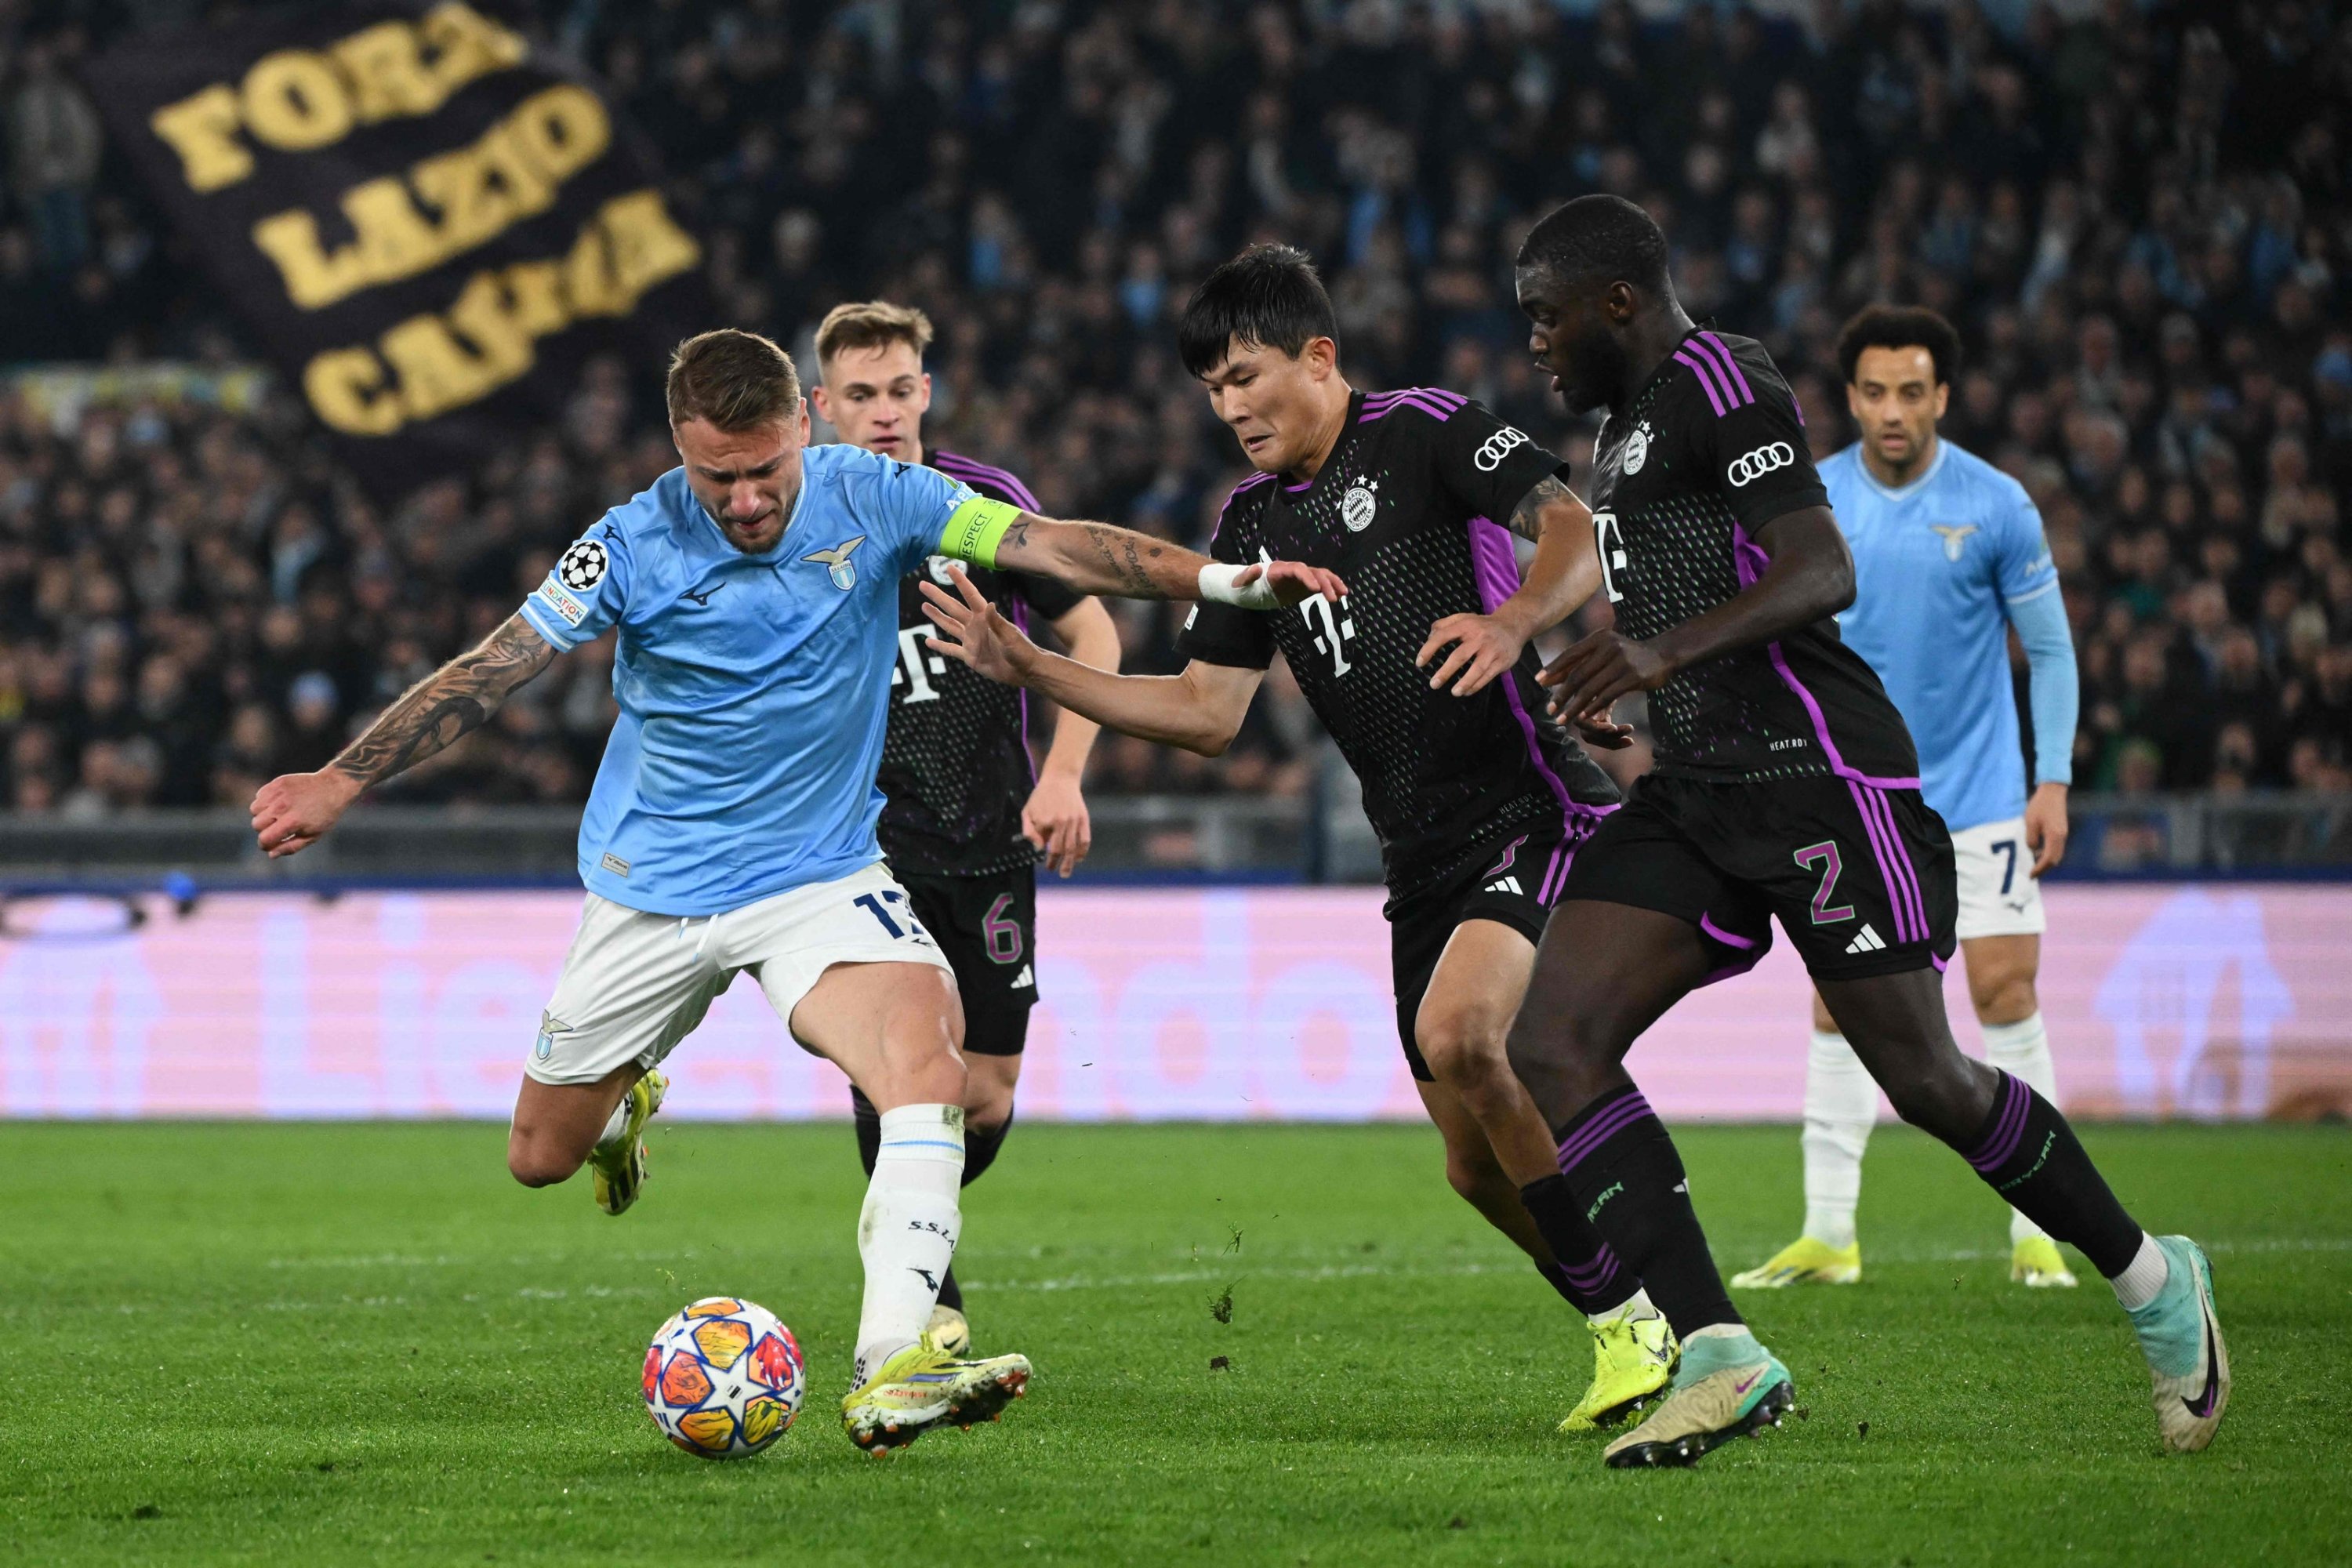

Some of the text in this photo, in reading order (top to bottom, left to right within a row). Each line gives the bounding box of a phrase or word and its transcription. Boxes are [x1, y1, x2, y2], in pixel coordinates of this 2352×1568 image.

[252, 83, 613, 310] LAZIO
[1348, 491, 1370, 503] BAYERN
[542, 583, 583, 619] UNDATION
[1769, 738, 1808, 752] HEAT.RDY
[1793, 840, 1856, 925] 2
[1991, 839, 2016, 895] 7
[982, 892, 1023, 965] 6
